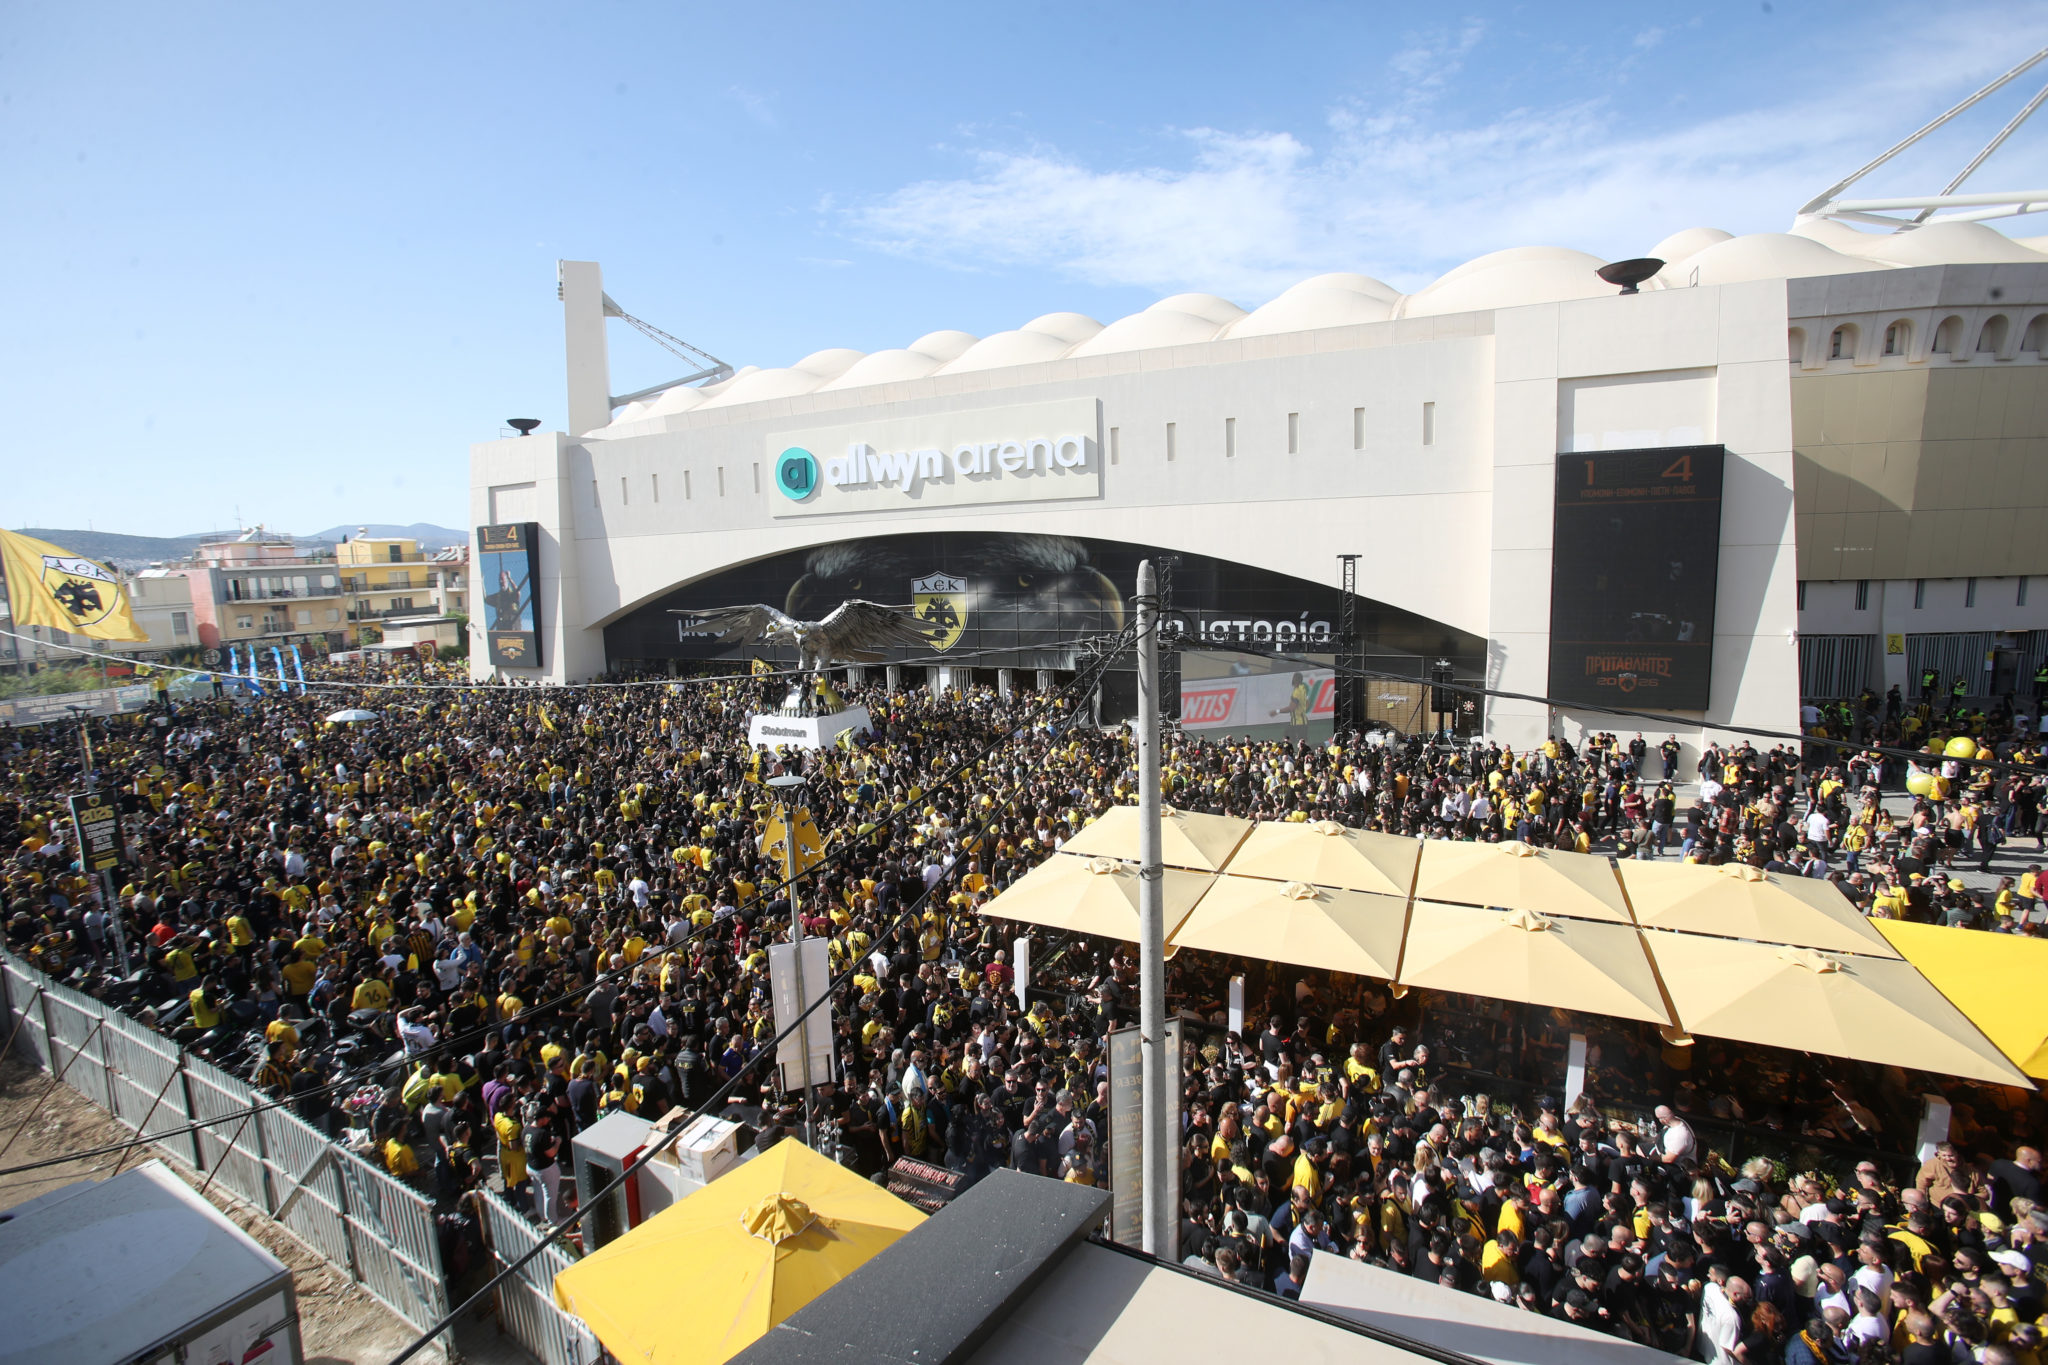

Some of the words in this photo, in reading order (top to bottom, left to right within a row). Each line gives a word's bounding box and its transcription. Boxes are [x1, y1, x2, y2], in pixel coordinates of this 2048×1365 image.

[824, 443, 944, 492] allwyn
[953, 435, 1087, 475] arena
[1181, 693, 1230, 720] NTIS
[80, 805, 115, 825] 2026
